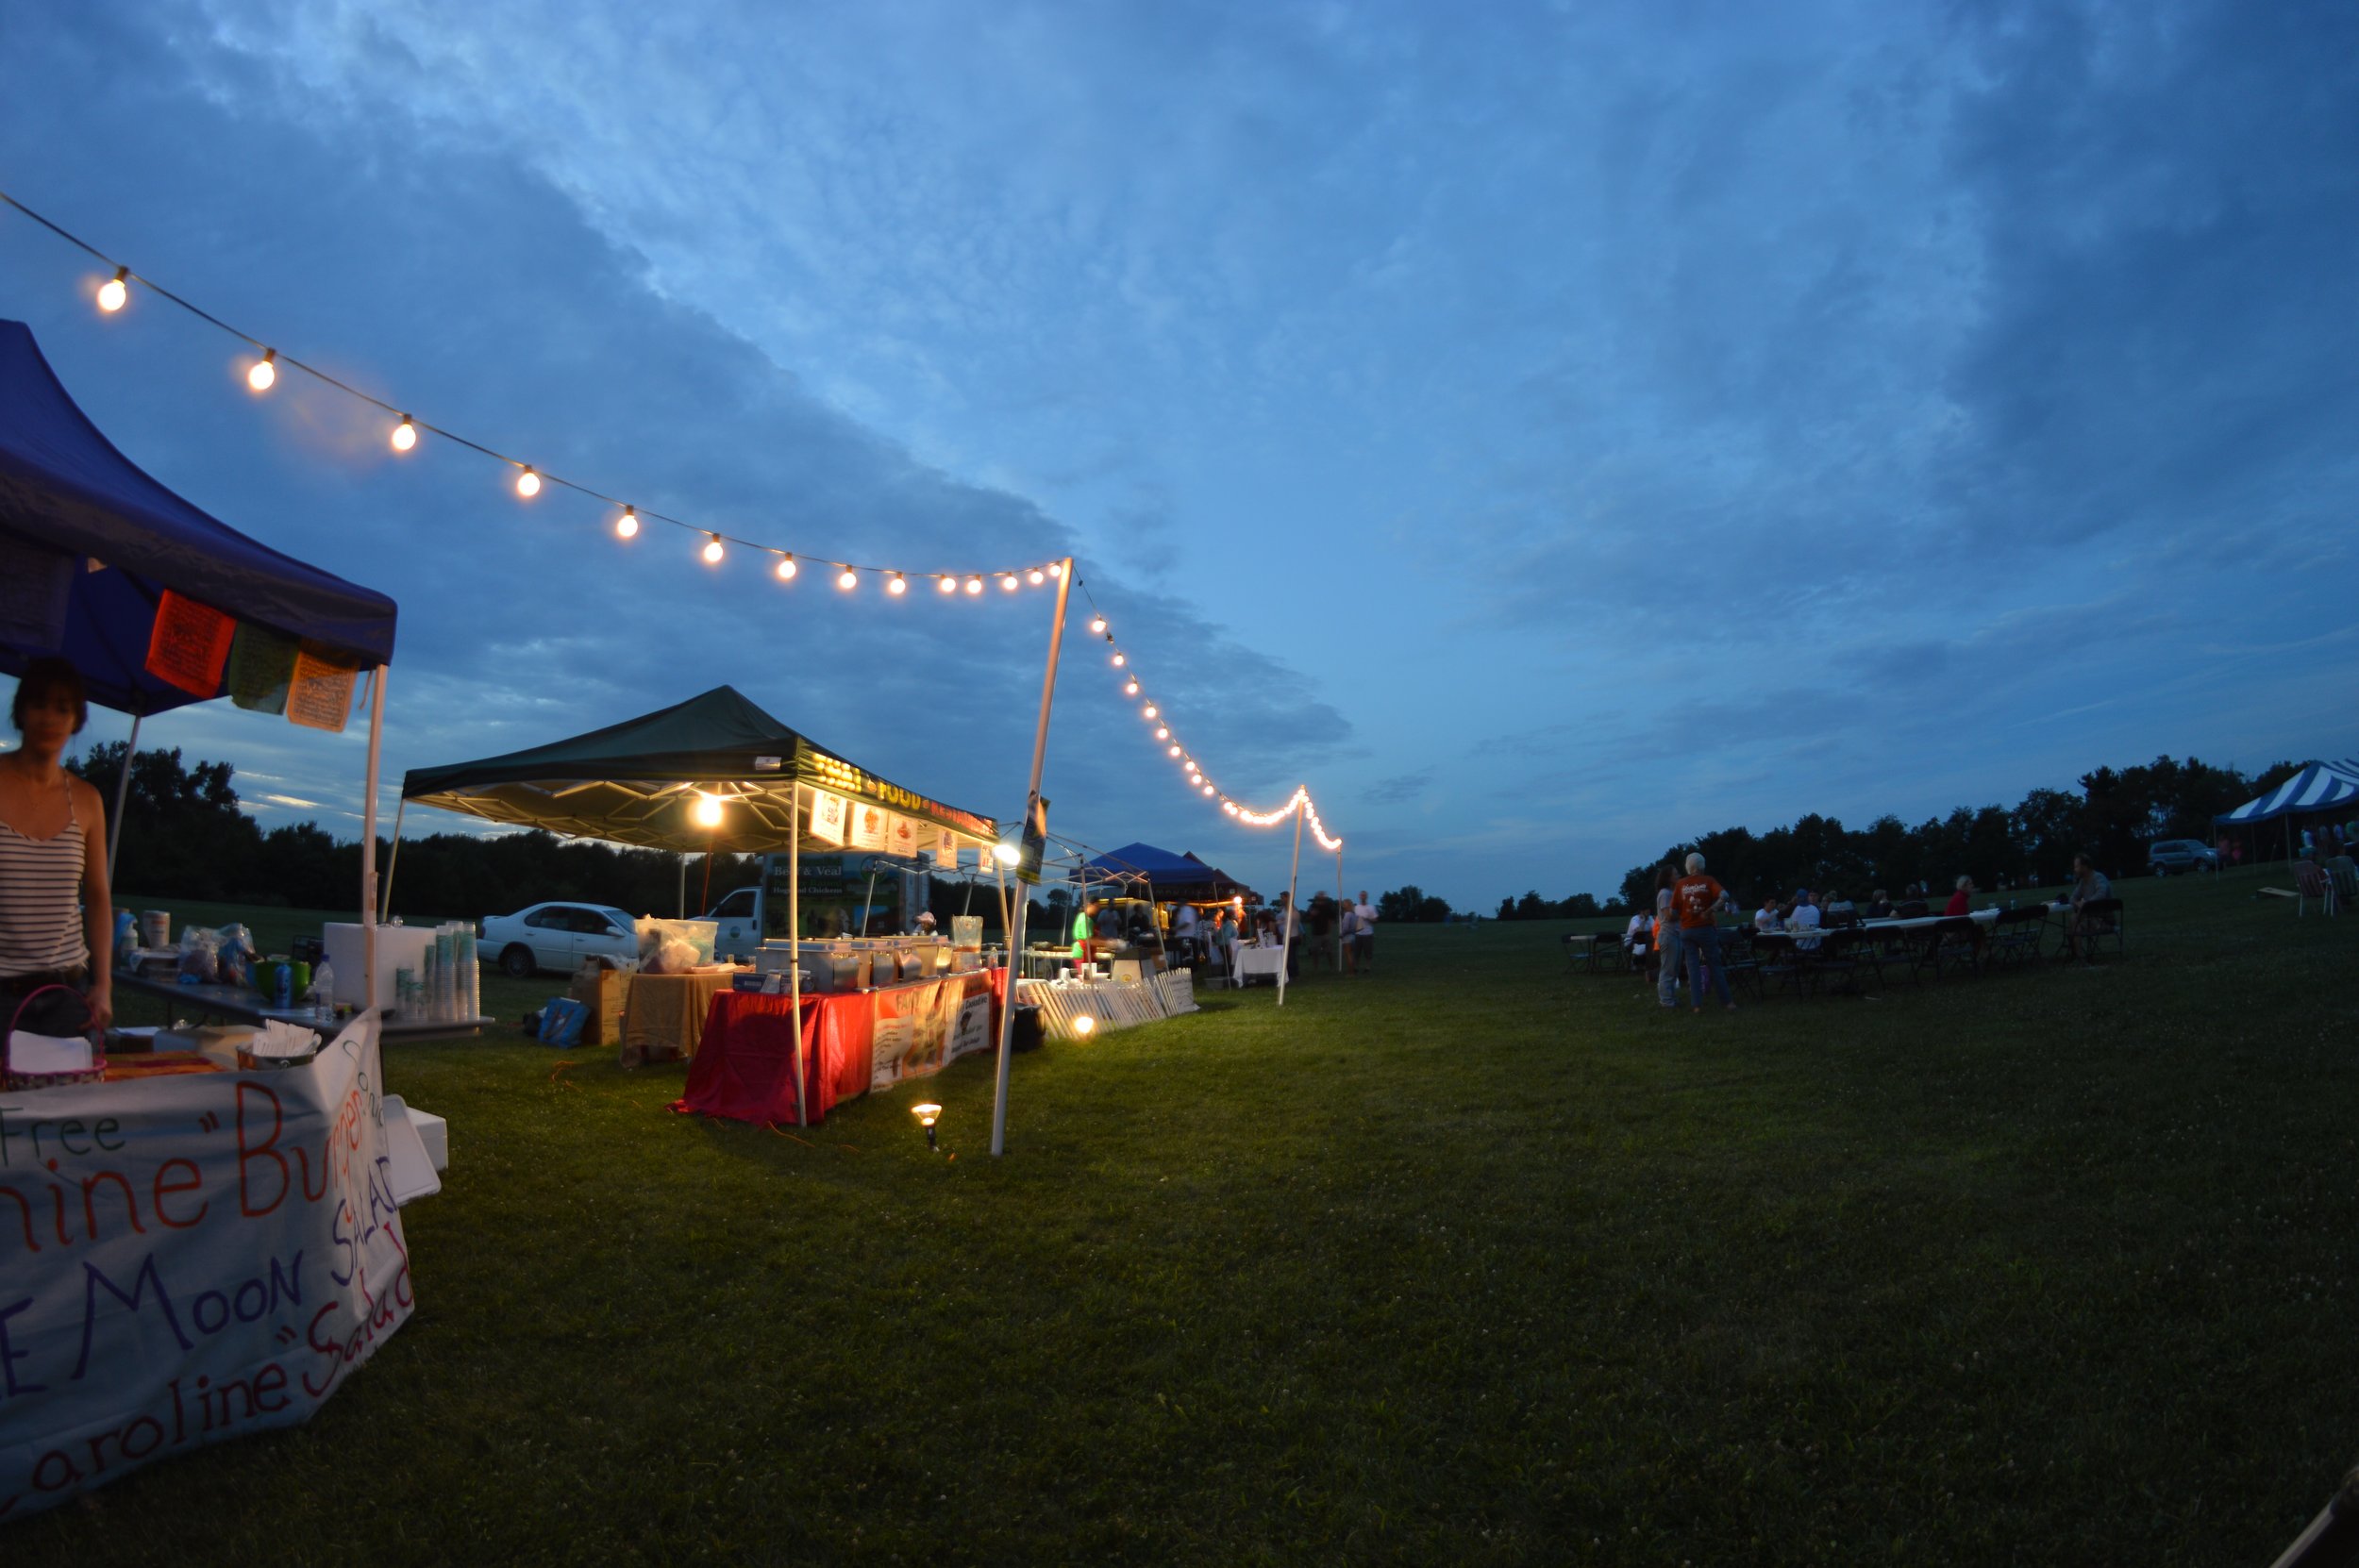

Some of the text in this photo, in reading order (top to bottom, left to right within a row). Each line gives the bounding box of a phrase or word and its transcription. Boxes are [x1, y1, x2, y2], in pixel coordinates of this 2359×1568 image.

[774, 865, 843, 876] Bef & Veal
[808, 886, 843, 894] Chickens
[0, 1107, 125, 1167] Free
[0, 1361, 292, 1511] aroline
